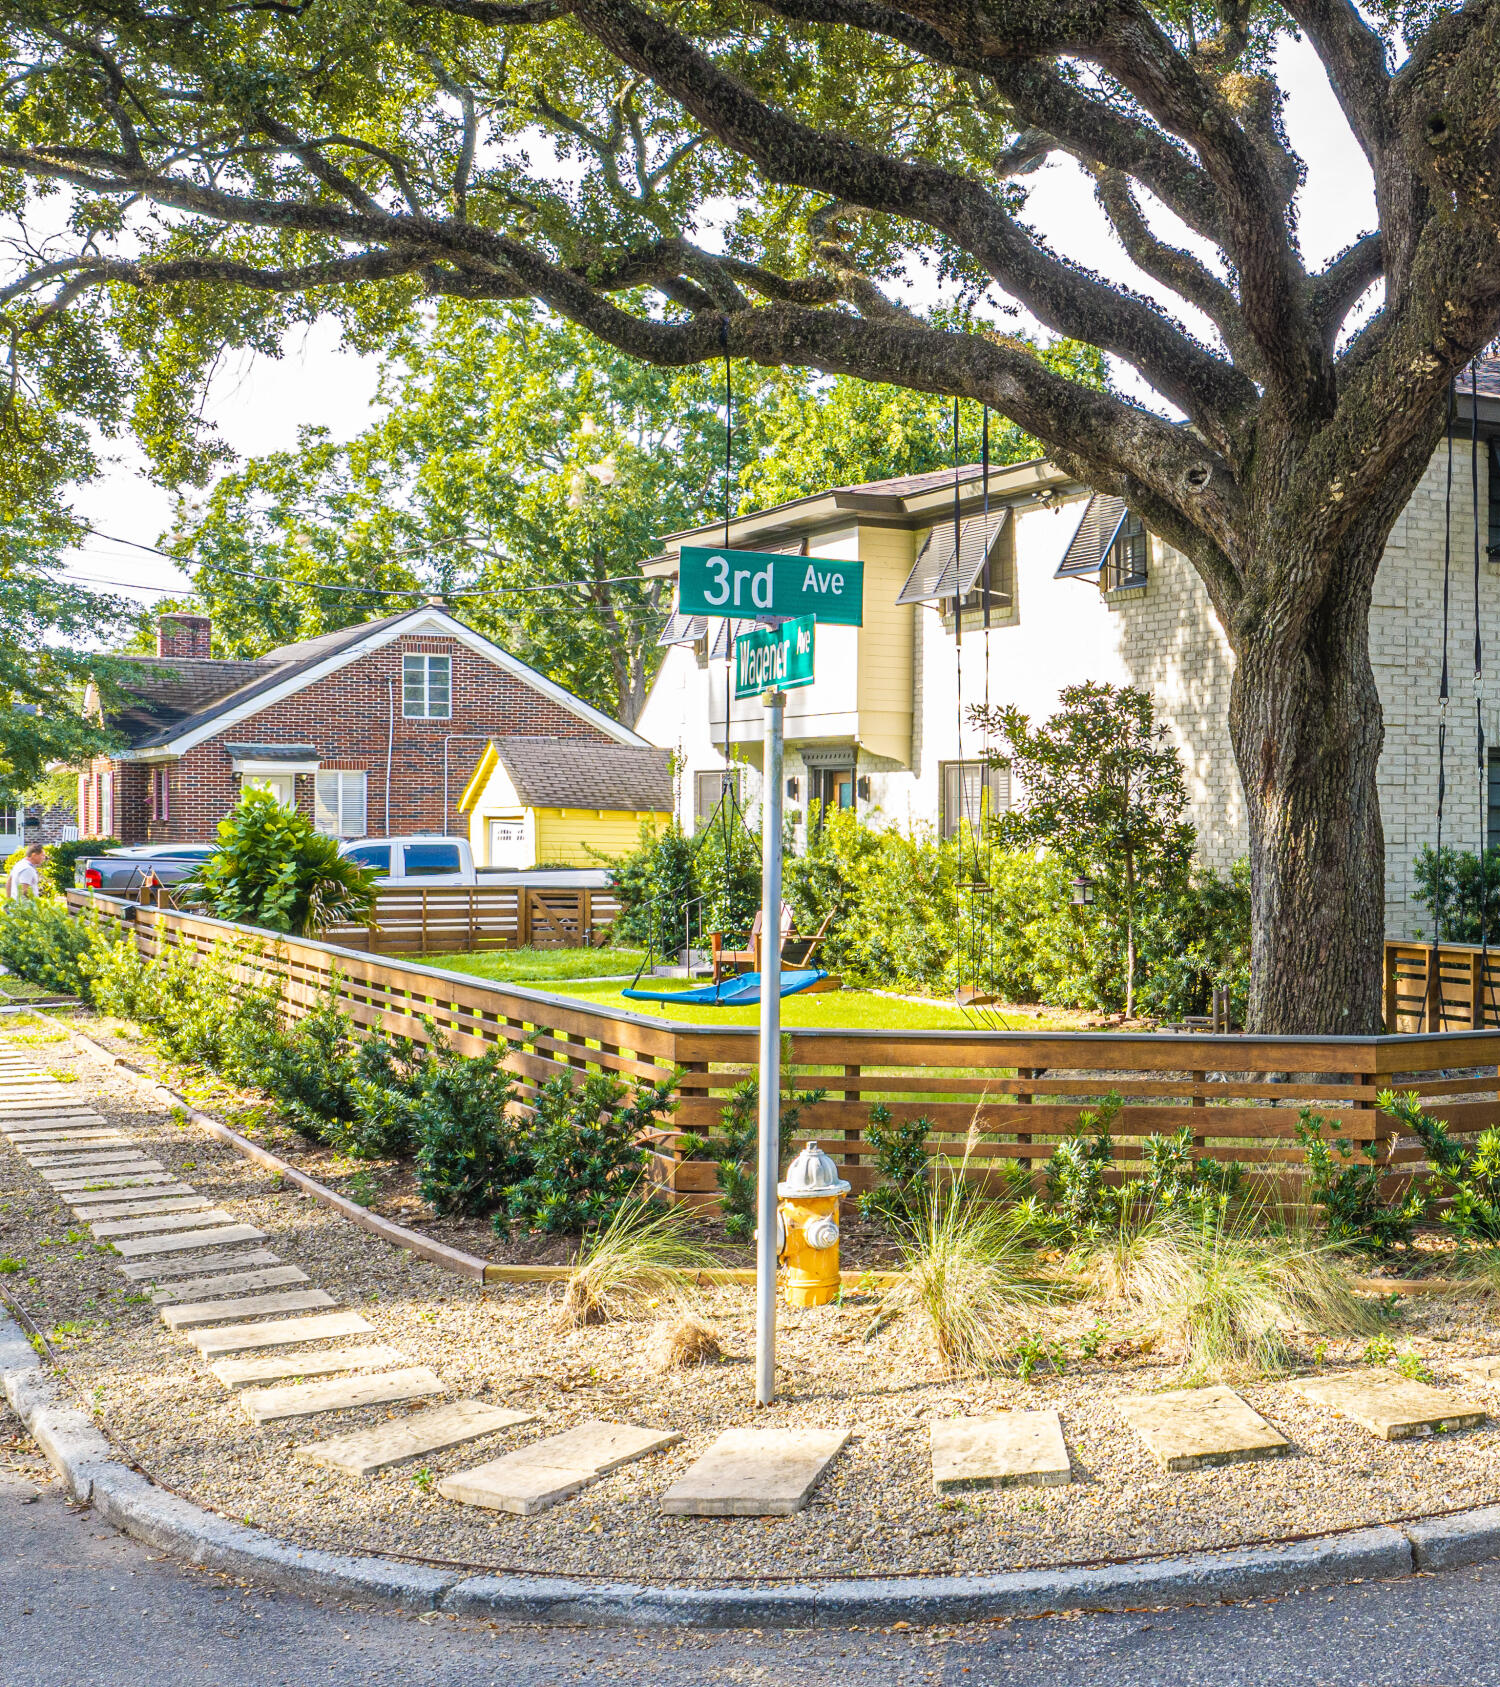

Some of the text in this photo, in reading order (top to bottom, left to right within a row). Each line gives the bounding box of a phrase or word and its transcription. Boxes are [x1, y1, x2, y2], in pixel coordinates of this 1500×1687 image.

[703, 555, 845, 608] 3rd Ave
[739, 626, 811, 693] Wagener Ave
